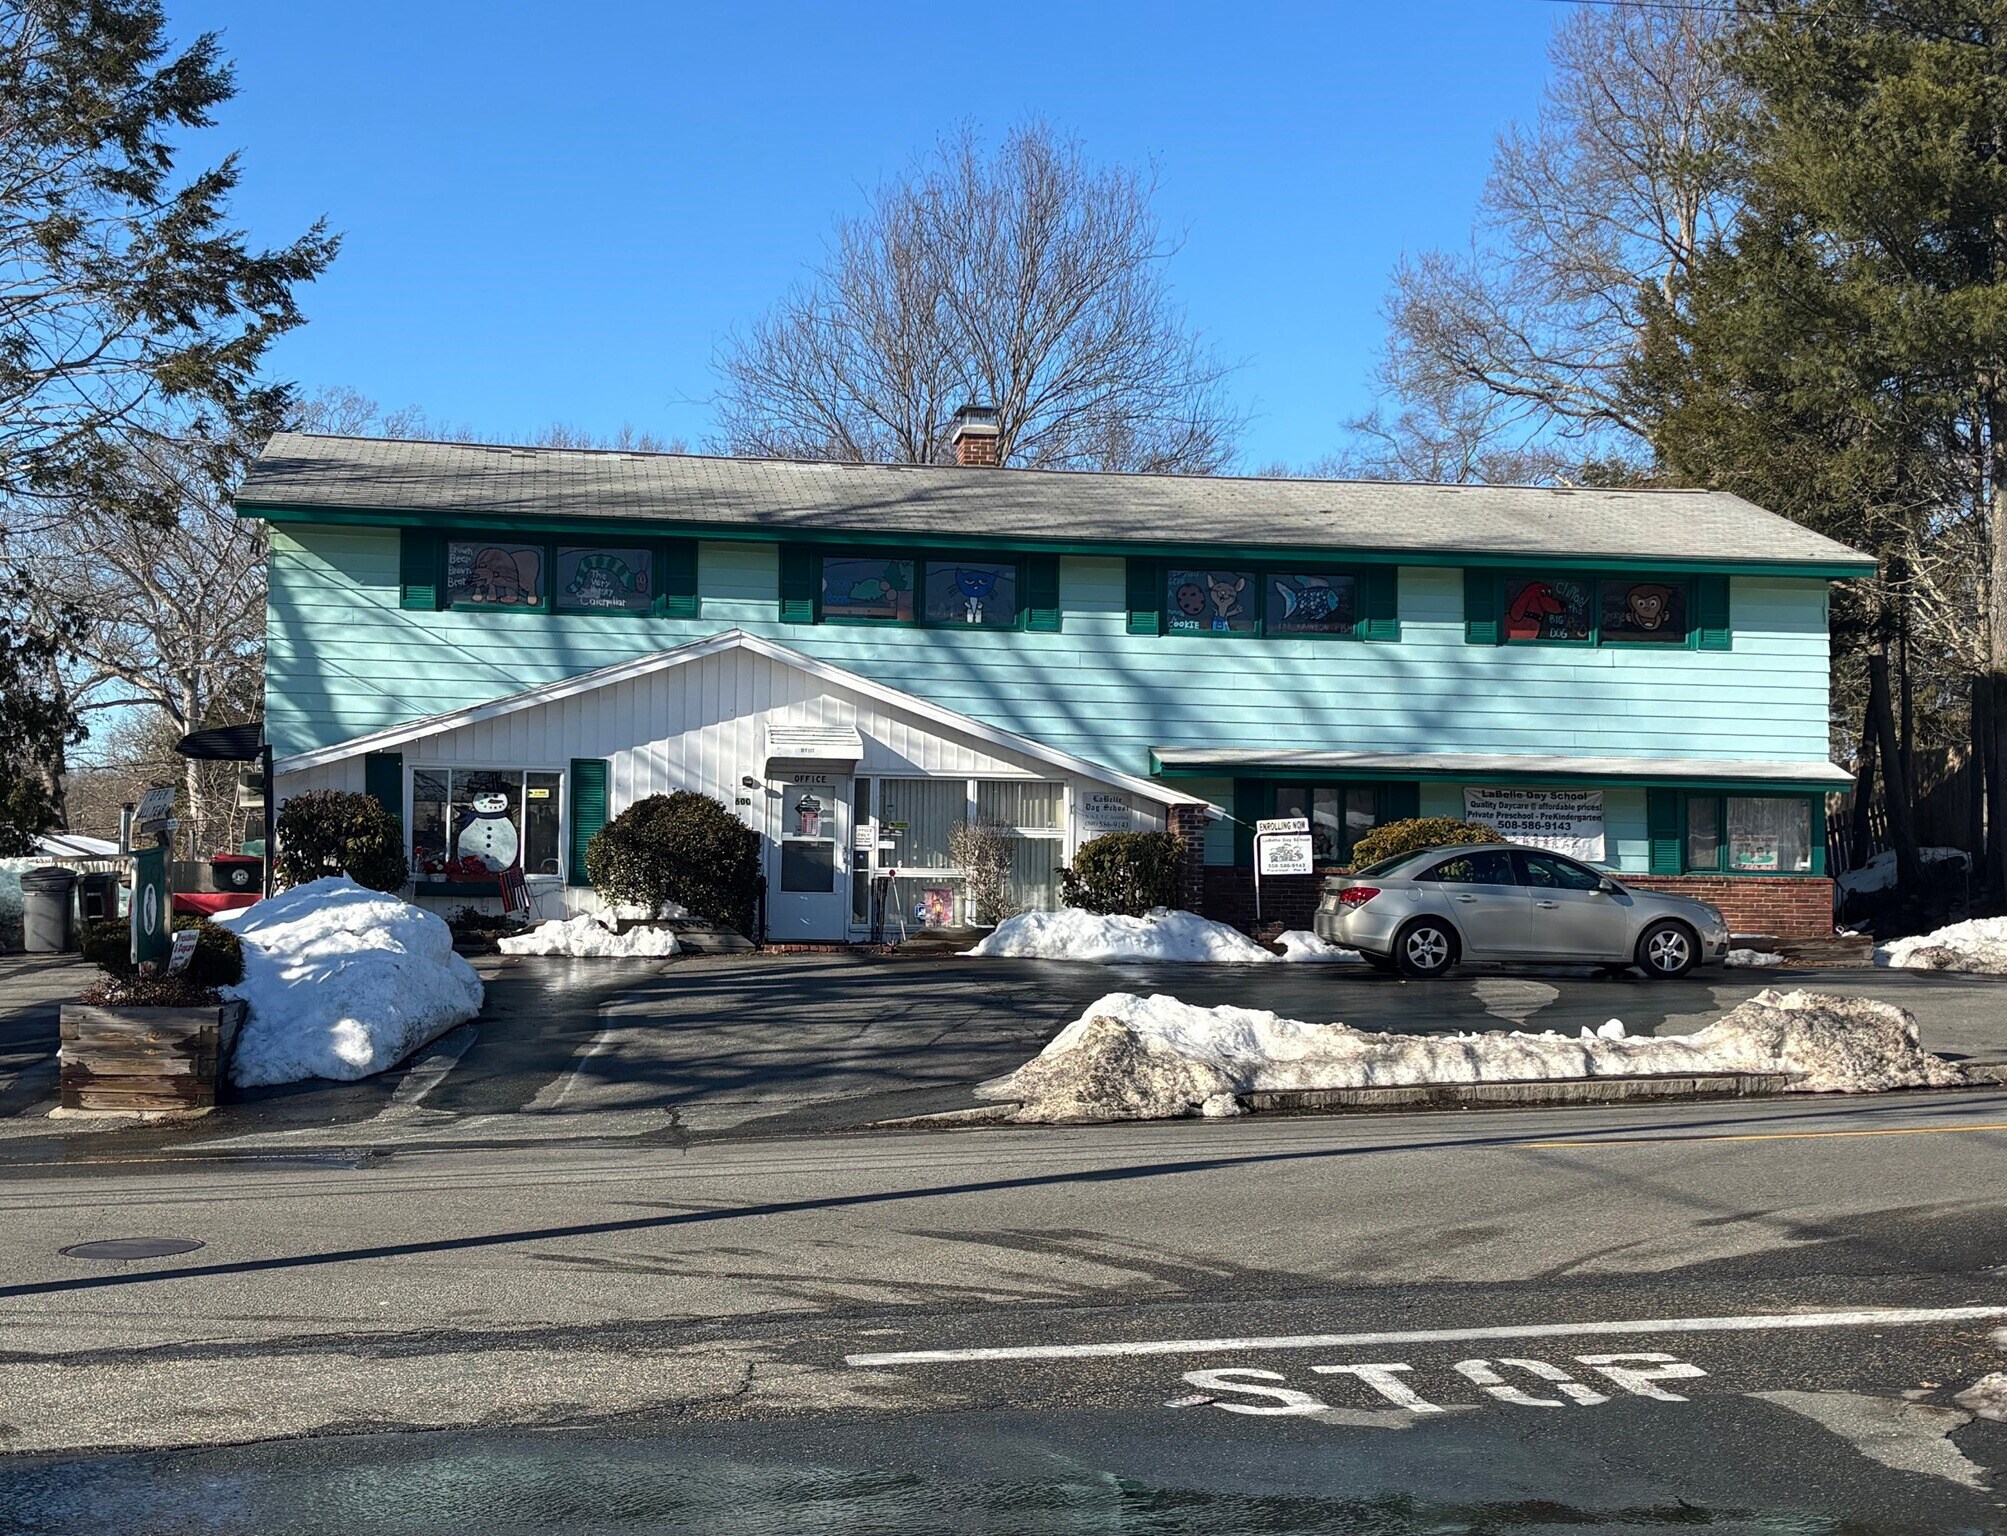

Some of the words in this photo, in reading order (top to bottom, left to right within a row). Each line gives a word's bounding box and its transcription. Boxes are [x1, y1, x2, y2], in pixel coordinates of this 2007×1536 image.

[590, 569, 607, 580] The
[1168, 620, 1200, 630] COOKIE
[1549, 614, 1565, 625] BIG
[1548, 628, 1568, 639] DOG
[794, 775, 827, 783] OFFICE
[1481, 789, 1523, 799] LaBelle
[1526, 791, 1547, 801] Day
[1550, 792, 1587, 800] School
[1470, 801, 1497, 810] Quality
[1498, 802, 1529, 811] Daycare
[1538, 803, 1575, 811] affordable
[1467, 811, 1494, 819] Private
[1496, 811, 1534, 820] Preschool
[1259, 821, 1291, 831] ENROLLING
[1292, 820, 1305, 829] NOW
[1497, 820, 1571, 830] 508-586-9143
[1164, 1352, 1708, 1415] STOP
